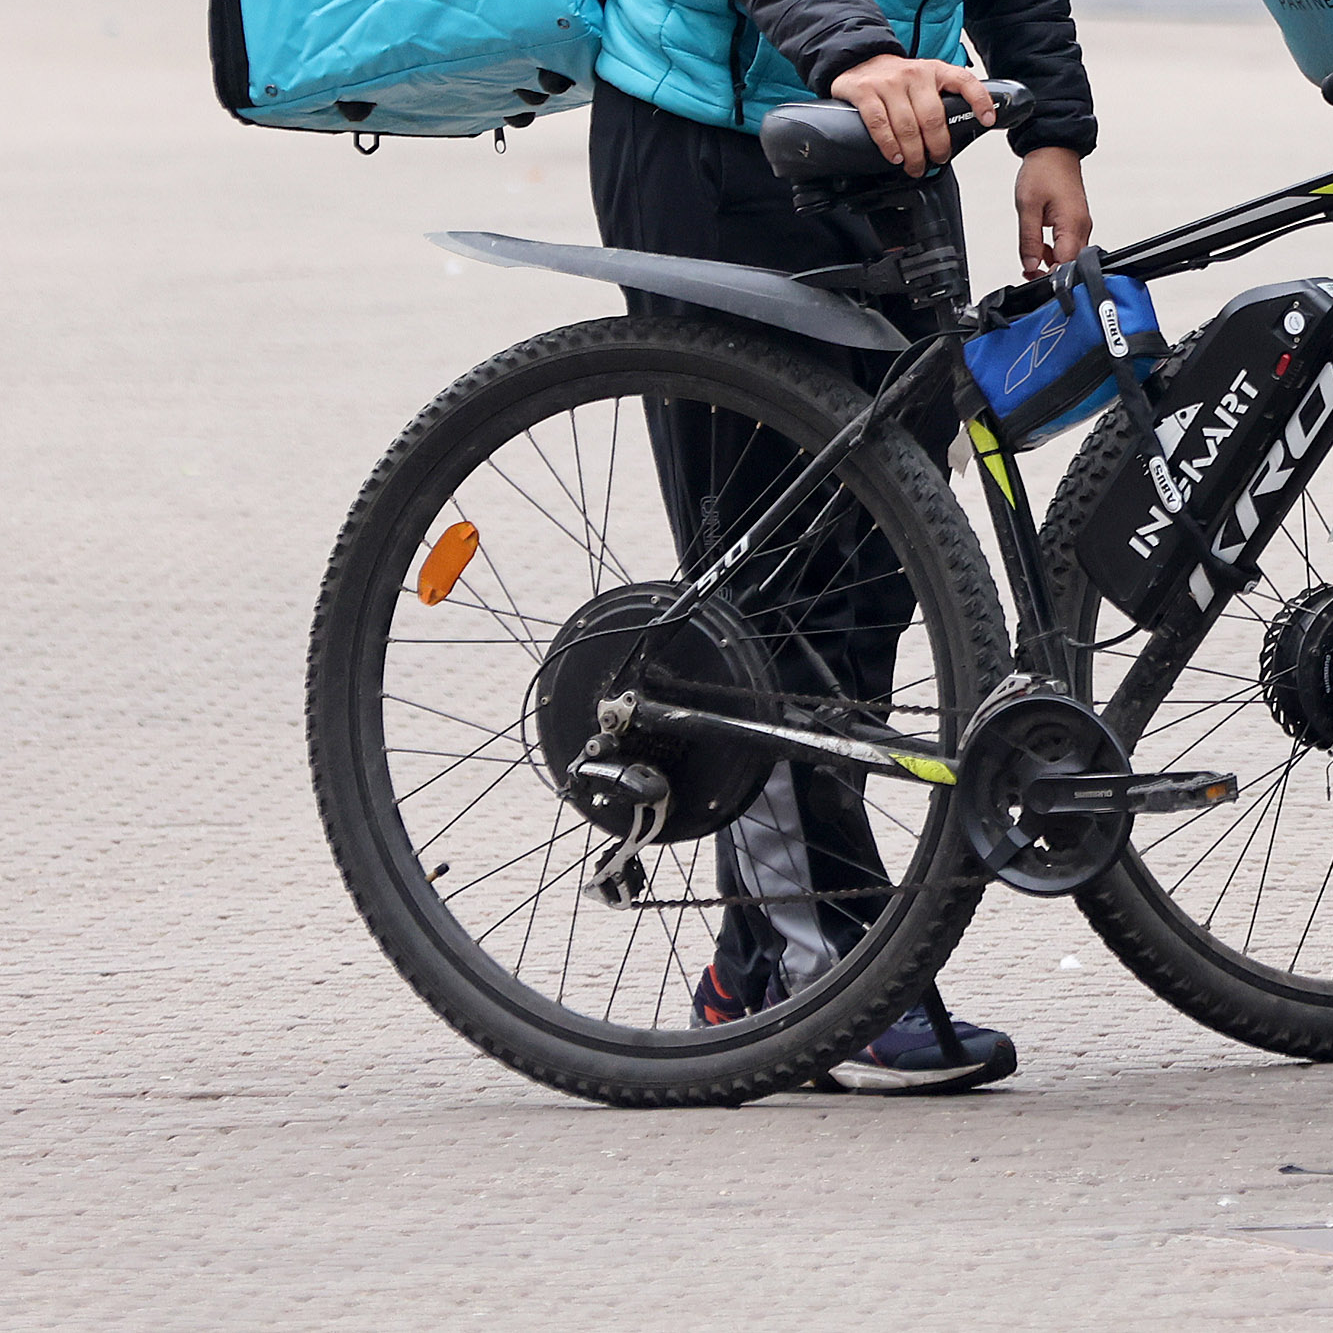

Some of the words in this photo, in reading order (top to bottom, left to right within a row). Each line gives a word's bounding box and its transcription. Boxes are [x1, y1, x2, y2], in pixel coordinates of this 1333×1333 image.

[1105, 308, 1124, 347] ABUS
[1154, 464, 1176, 505] ABUS
[697, 535, 749, 597] 5.0
